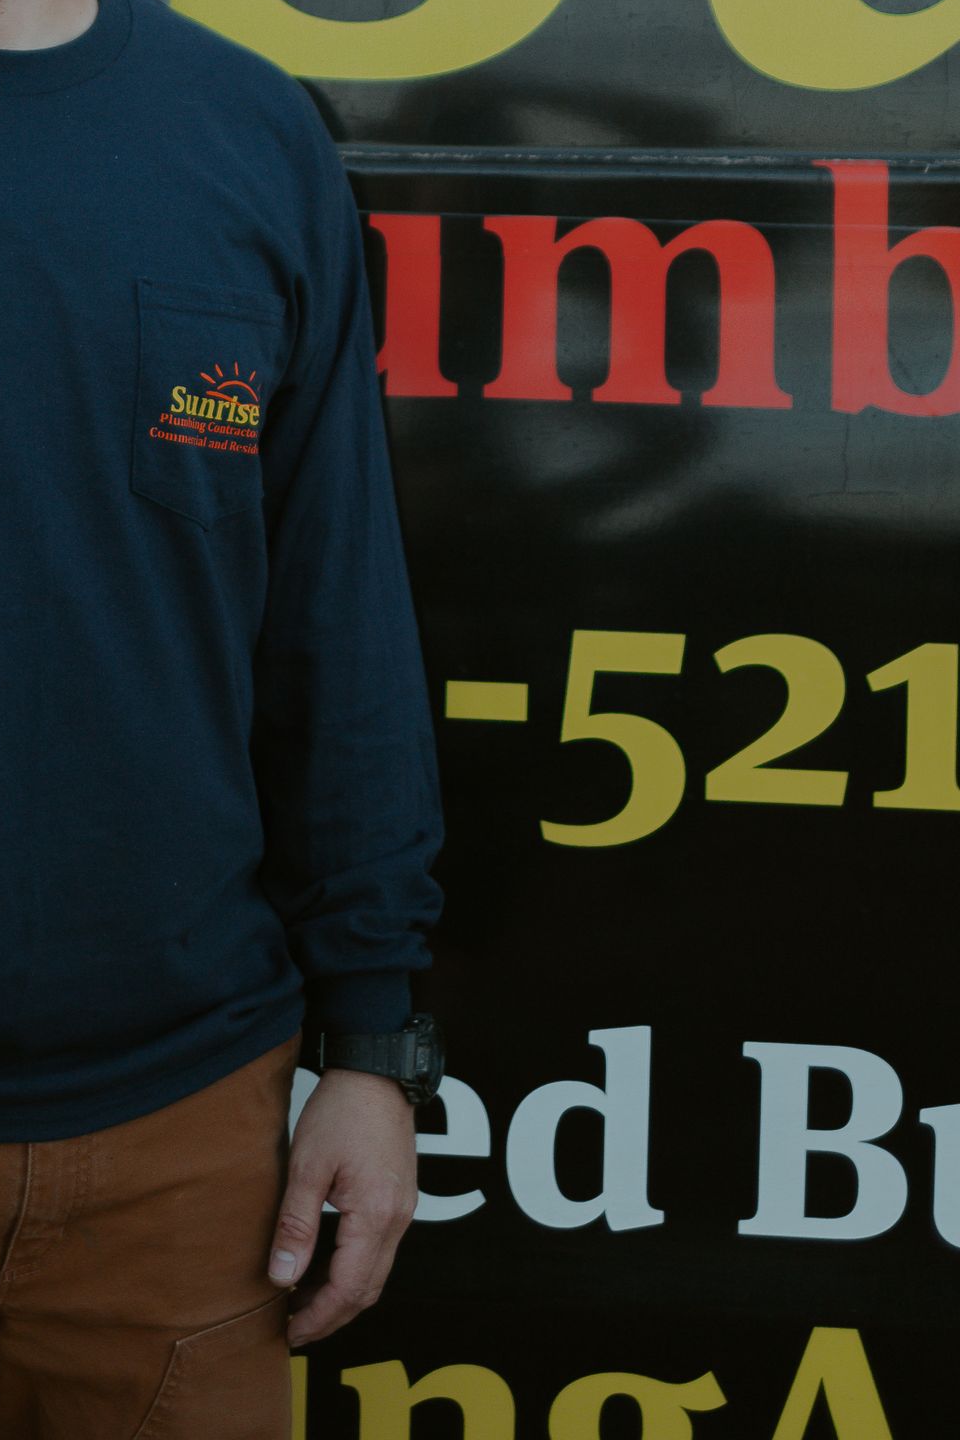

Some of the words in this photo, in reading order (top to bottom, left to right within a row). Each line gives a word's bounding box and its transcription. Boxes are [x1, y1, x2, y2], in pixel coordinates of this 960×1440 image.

[160, 412, 206, 434] Plumbing
[170, 385, 260, 426] Sunrise
[149, 426, 207, 448] Commerial
[208, 439, 228, 450] and
[230, 440, 259, 455] Resid
[290, 1025, 664, 1232] ed
